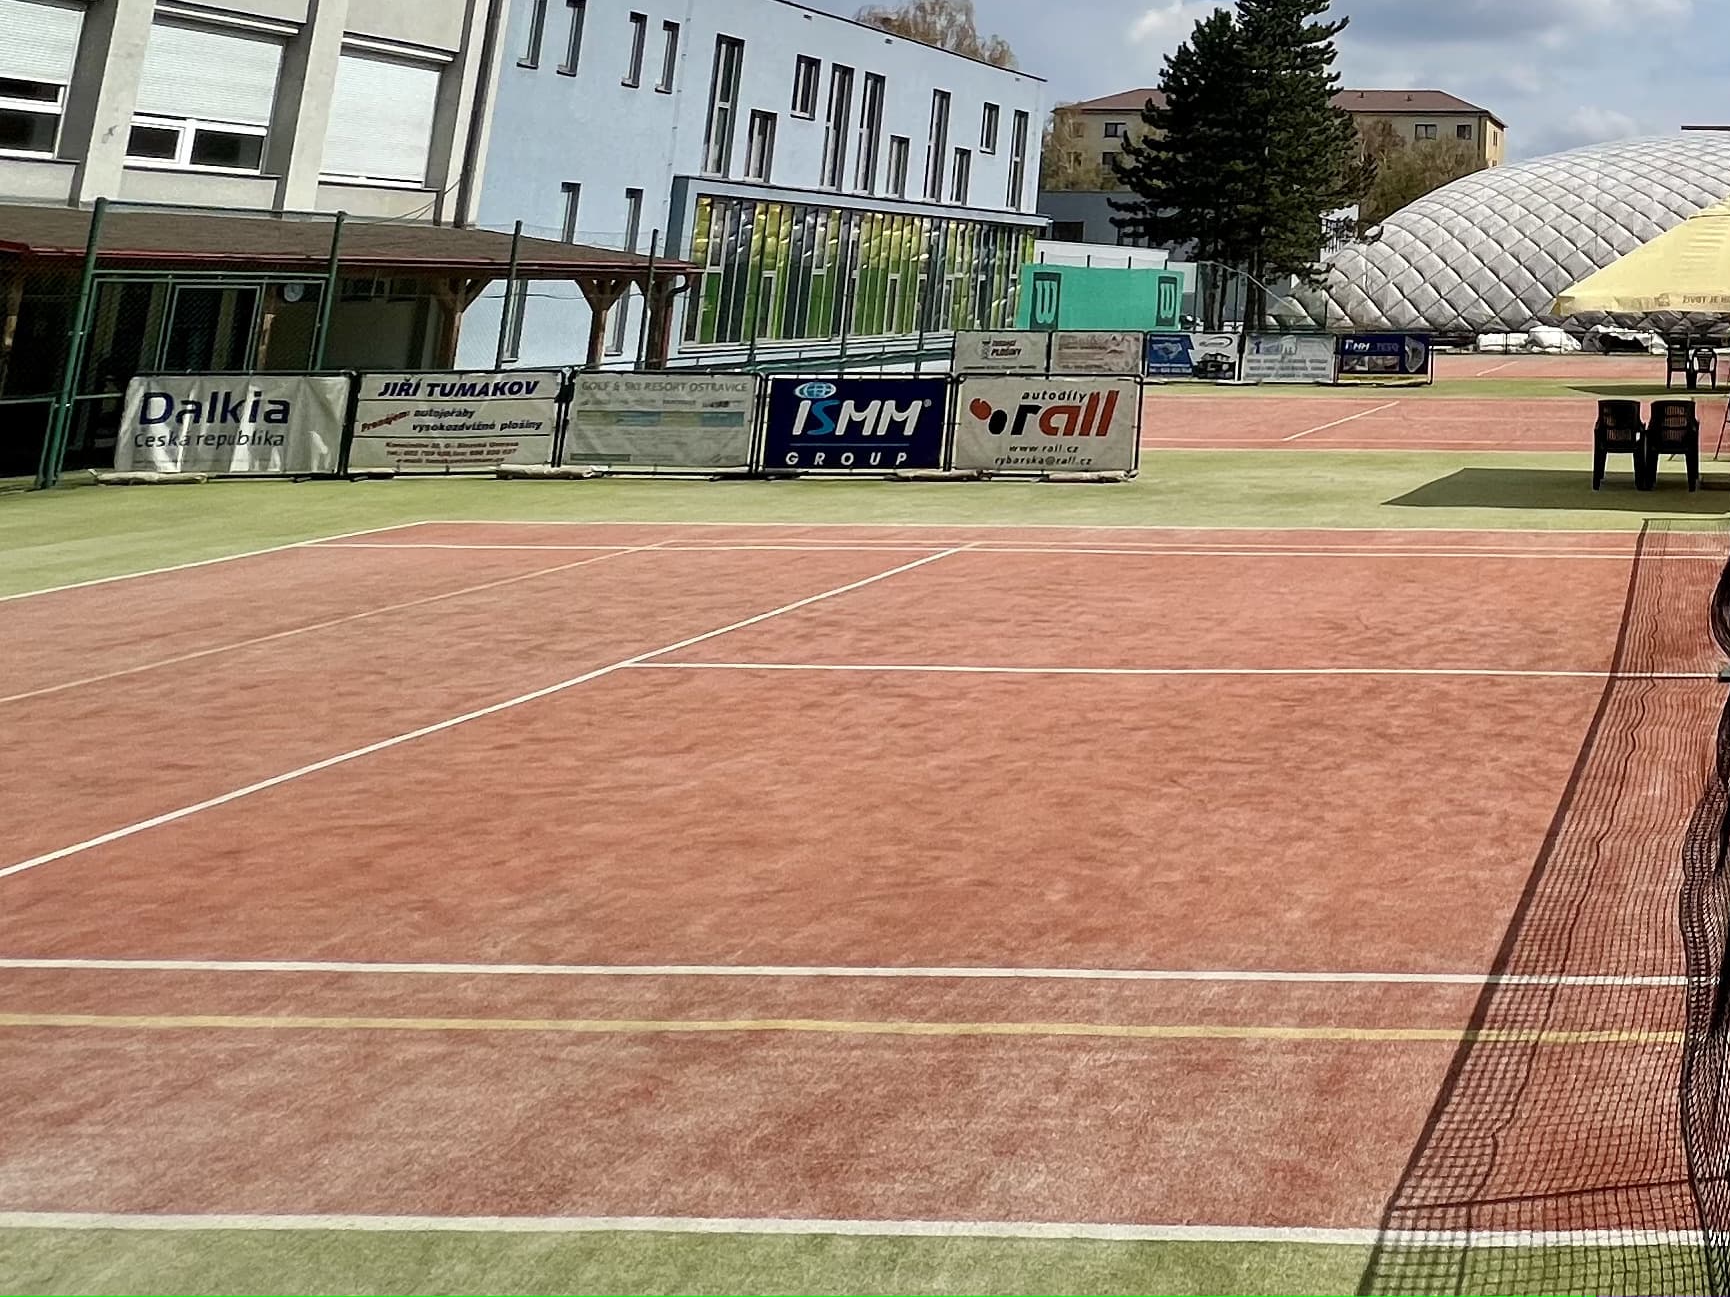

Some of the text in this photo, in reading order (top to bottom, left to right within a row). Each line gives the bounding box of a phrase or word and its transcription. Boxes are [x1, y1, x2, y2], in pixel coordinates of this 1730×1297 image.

[378, 376, 541, 398] JIŘÍ TUMAKOV
[581, 381, 611, 391] GOLF
[643, 382, 686, 392] RESORT
[689, 382, 748, 392] OSTRAVICE
[1021, 389, 1087, 403] autodíly
[139, 391, 291, 425] Dalkia
[1010, 390, 1120, 436] rall
[195, 430, 285, 450] republika
[785, 451, 908, 466] GROUP
